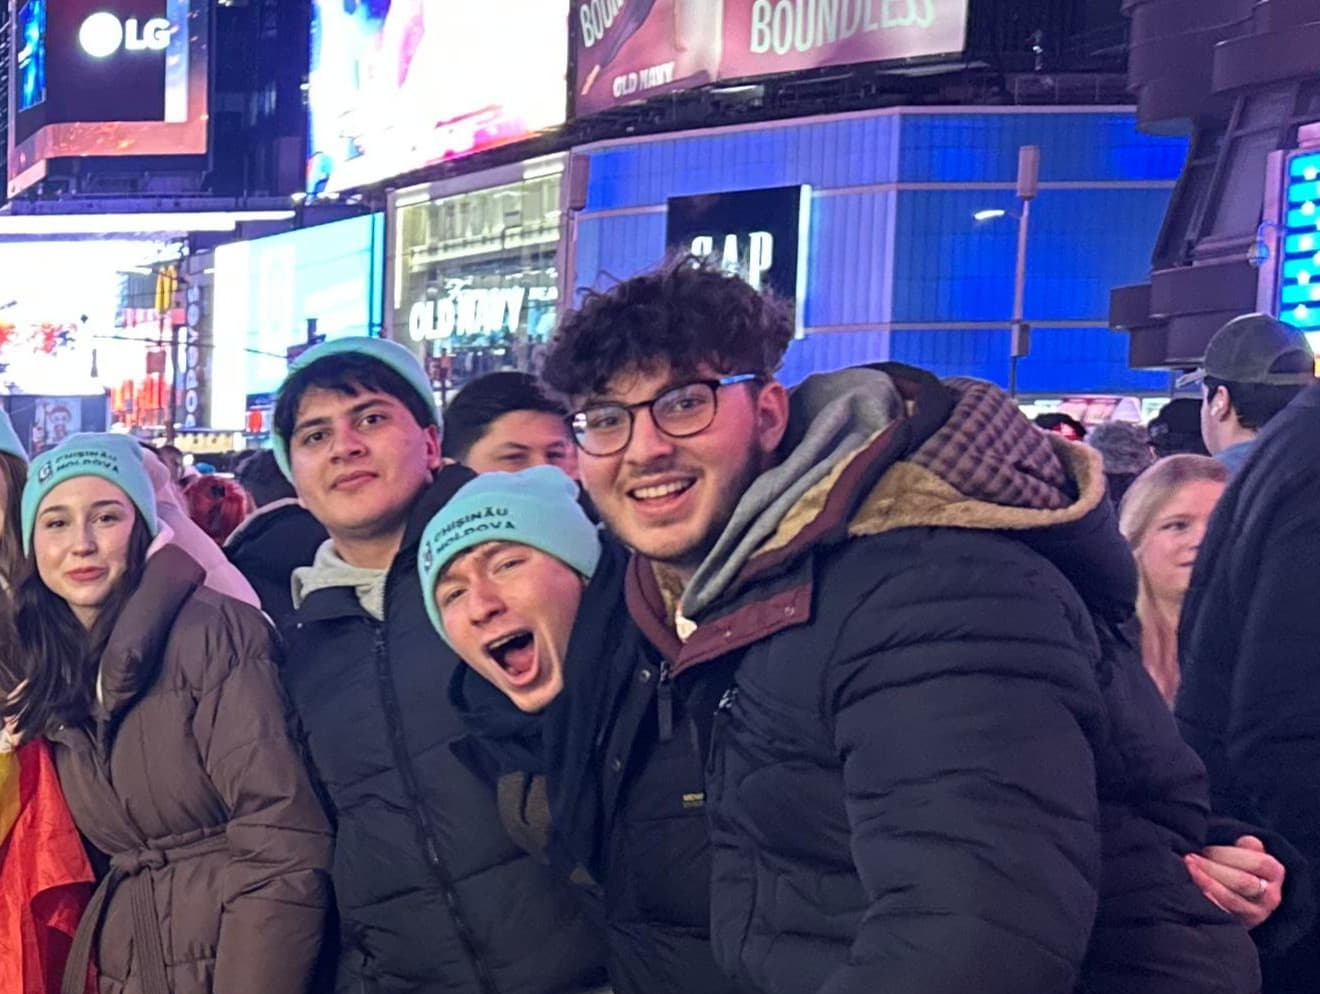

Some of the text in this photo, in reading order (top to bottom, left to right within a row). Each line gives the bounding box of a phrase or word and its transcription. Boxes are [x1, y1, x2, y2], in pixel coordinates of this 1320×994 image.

[125, 18, 171, 50] LG
[612, 61, 676, 97] OLD NAVY
[409, 297, 455, 341] OLD
[436, 521, 515, 554] MOLDOVA
